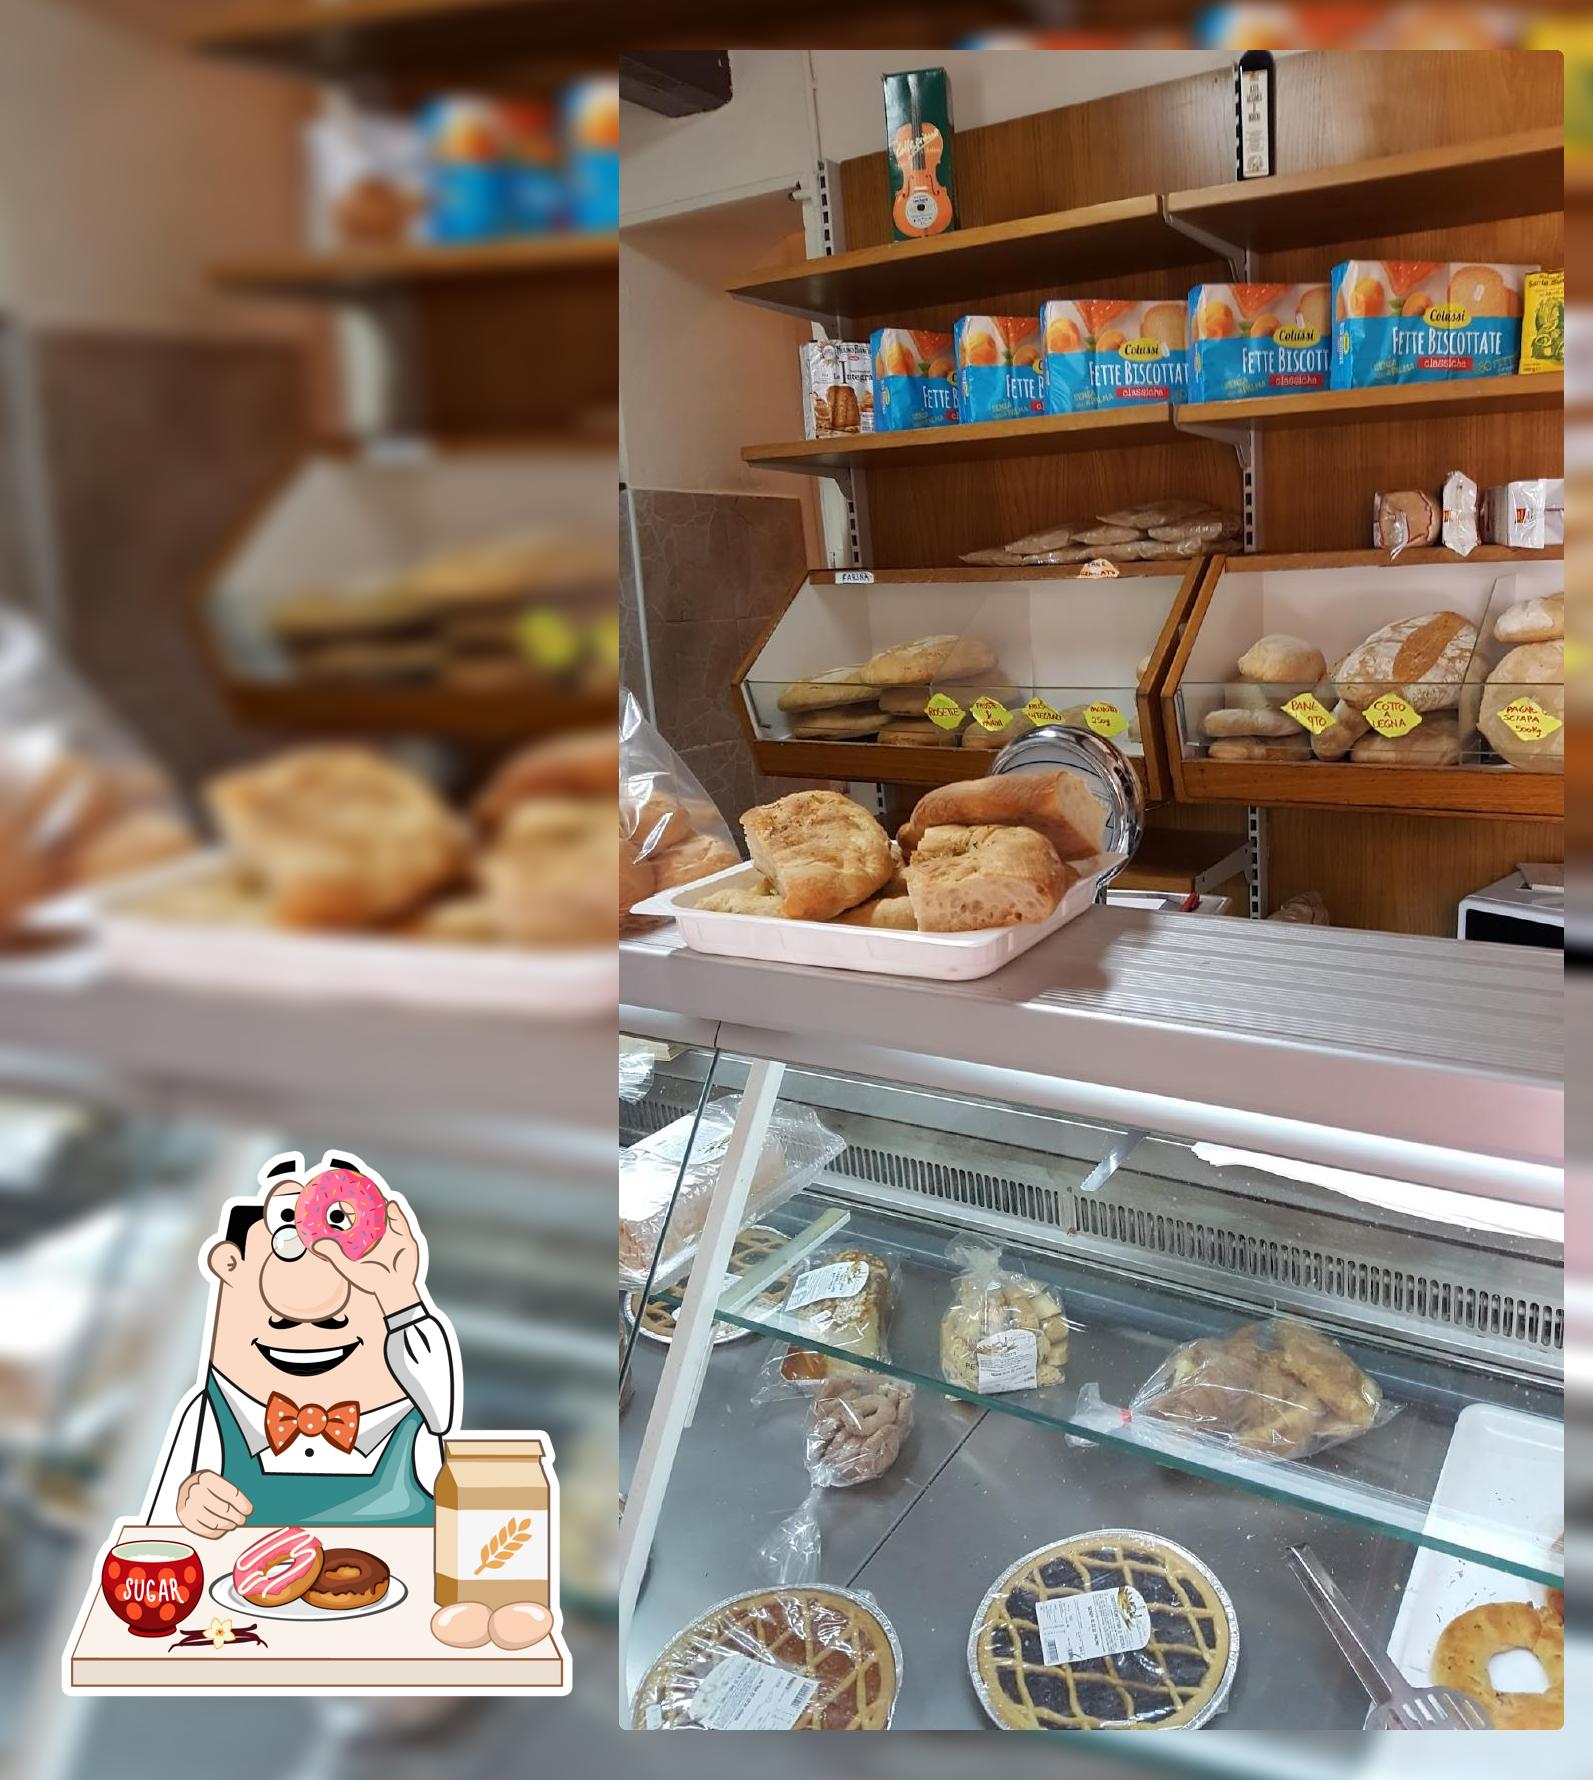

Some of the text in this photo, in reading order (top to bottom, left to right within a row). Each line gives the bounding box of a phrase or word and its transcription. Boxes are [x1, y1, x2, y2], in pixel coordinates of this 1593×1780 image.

[1430, 308, 1466, 322] Colussi
[1279, 330, 1314, 341] Colussi
[1392, 326, 1503, 355] FETTE BISCOTTATE
[1125, 343, 1159, 355] Colussi
[1242, 347, 1330, 374] FETTE BISCOTT
[1089, 361, 1190, 386] FETTE BISCOTTAT
[1006, 374, 1035, 399] FETTE
[922, 385, 951, 409] FETTE
[842, 572, 870, 582] FARINA
[1291, 701, 1319, 712] PANE
[1374, 701, 1406, 712] COTTO
[1384, 711, 1391, 719] A
[1372, 718, 1407, 730] LEGNA
